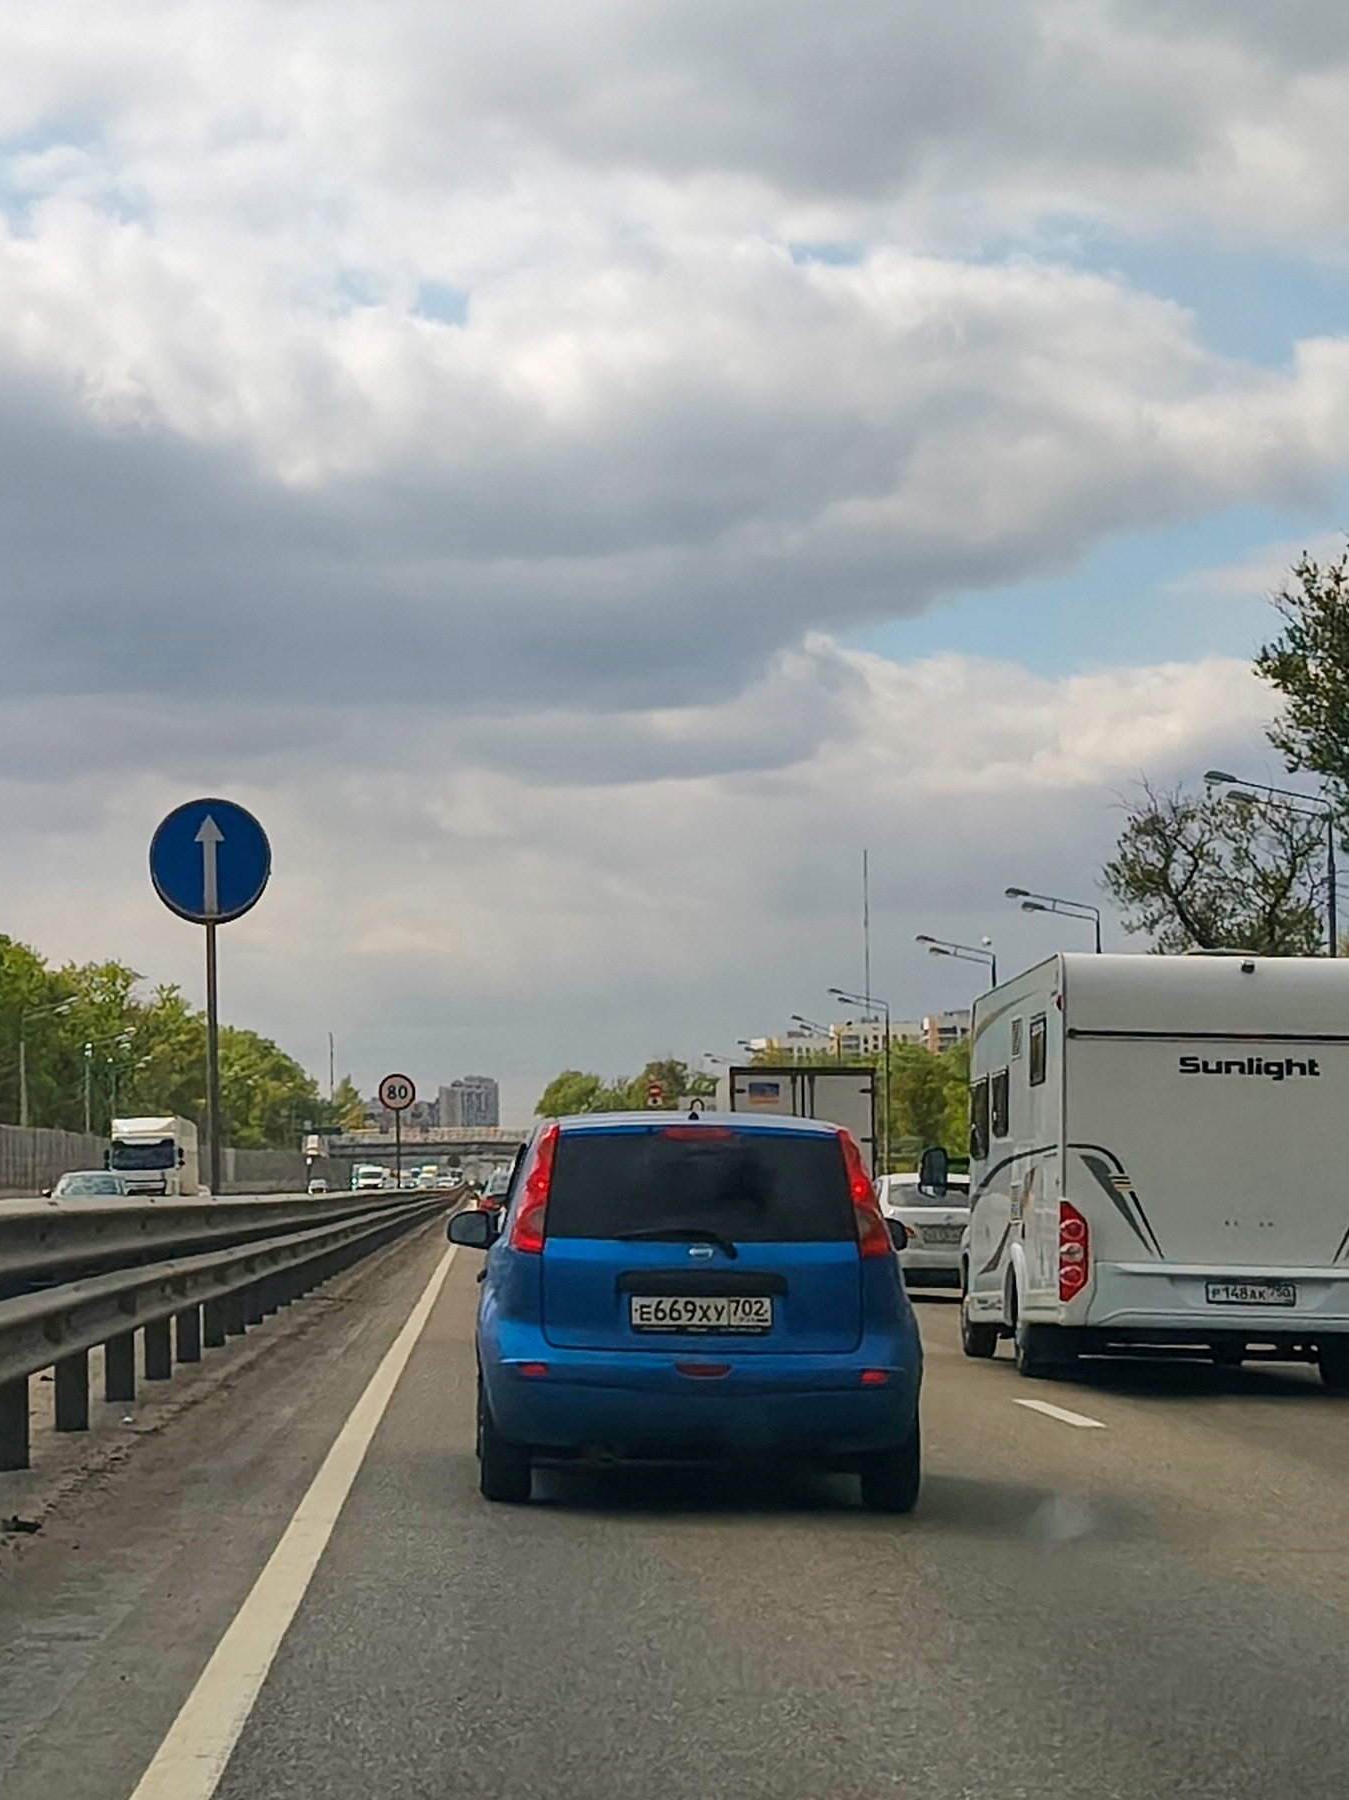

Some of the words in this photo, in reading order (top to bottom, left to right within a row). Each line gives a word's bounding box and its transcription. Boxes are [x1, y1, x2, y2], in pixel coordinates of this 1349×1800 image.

[1179, 1056, 1320, 1081] Sunlight
[387, 1084, 408, 1100] 80
[639, 1299, 725, 1322] Е669ХУ
[730, 1300, 764, 1317] 702
